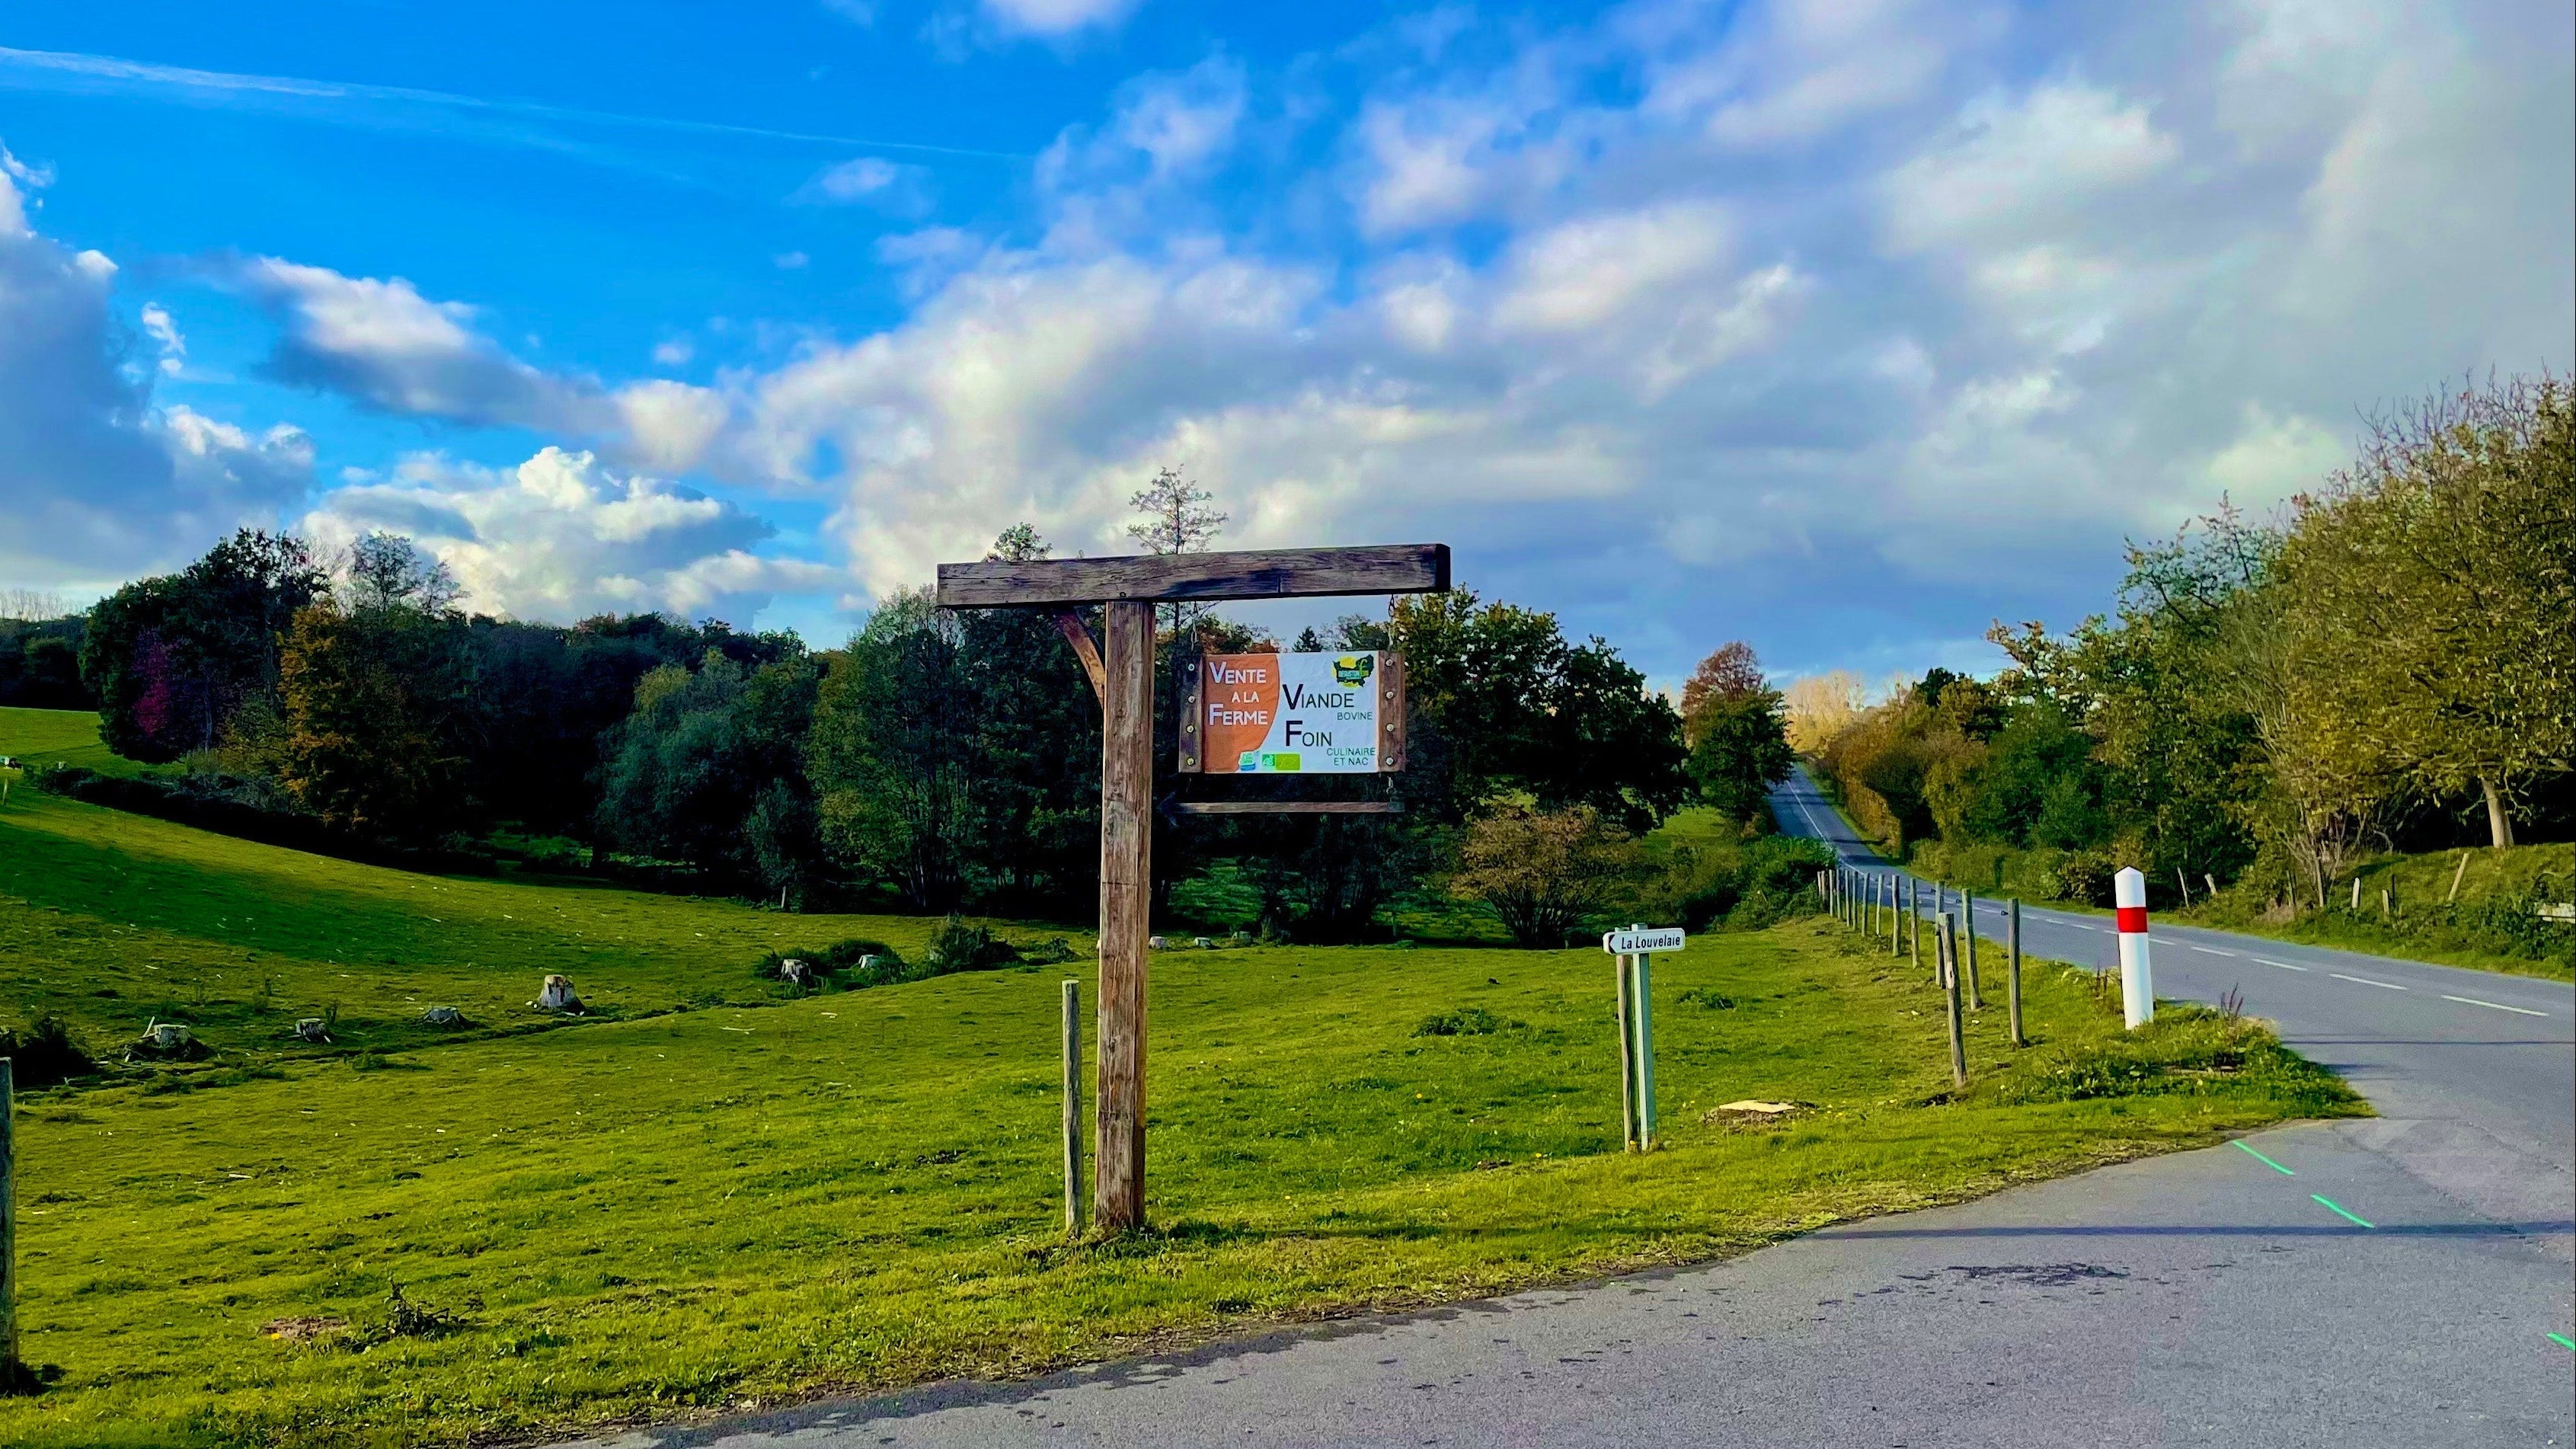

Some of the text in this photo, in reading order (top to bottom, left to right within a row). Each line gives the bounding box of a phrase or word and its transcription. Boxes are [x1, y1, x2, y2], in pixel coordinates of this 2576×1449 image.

[1209, 661, 1267, 684] VENTE
[1231, 691, 1260, 703] A LA
[1282, 683, 1354, 710] VIANDE
[1208, 703, 1268, 726] FERME
[1337, 711, 1373, 721] BOVINE
[1285, 720, 1331, 747] FOIN
[1326, 747, 1376, 756] CULINAIRE
[1334, 756, 1369, 766] ET NAC
[1621, 934, 1680, 950] La Louvelaie
